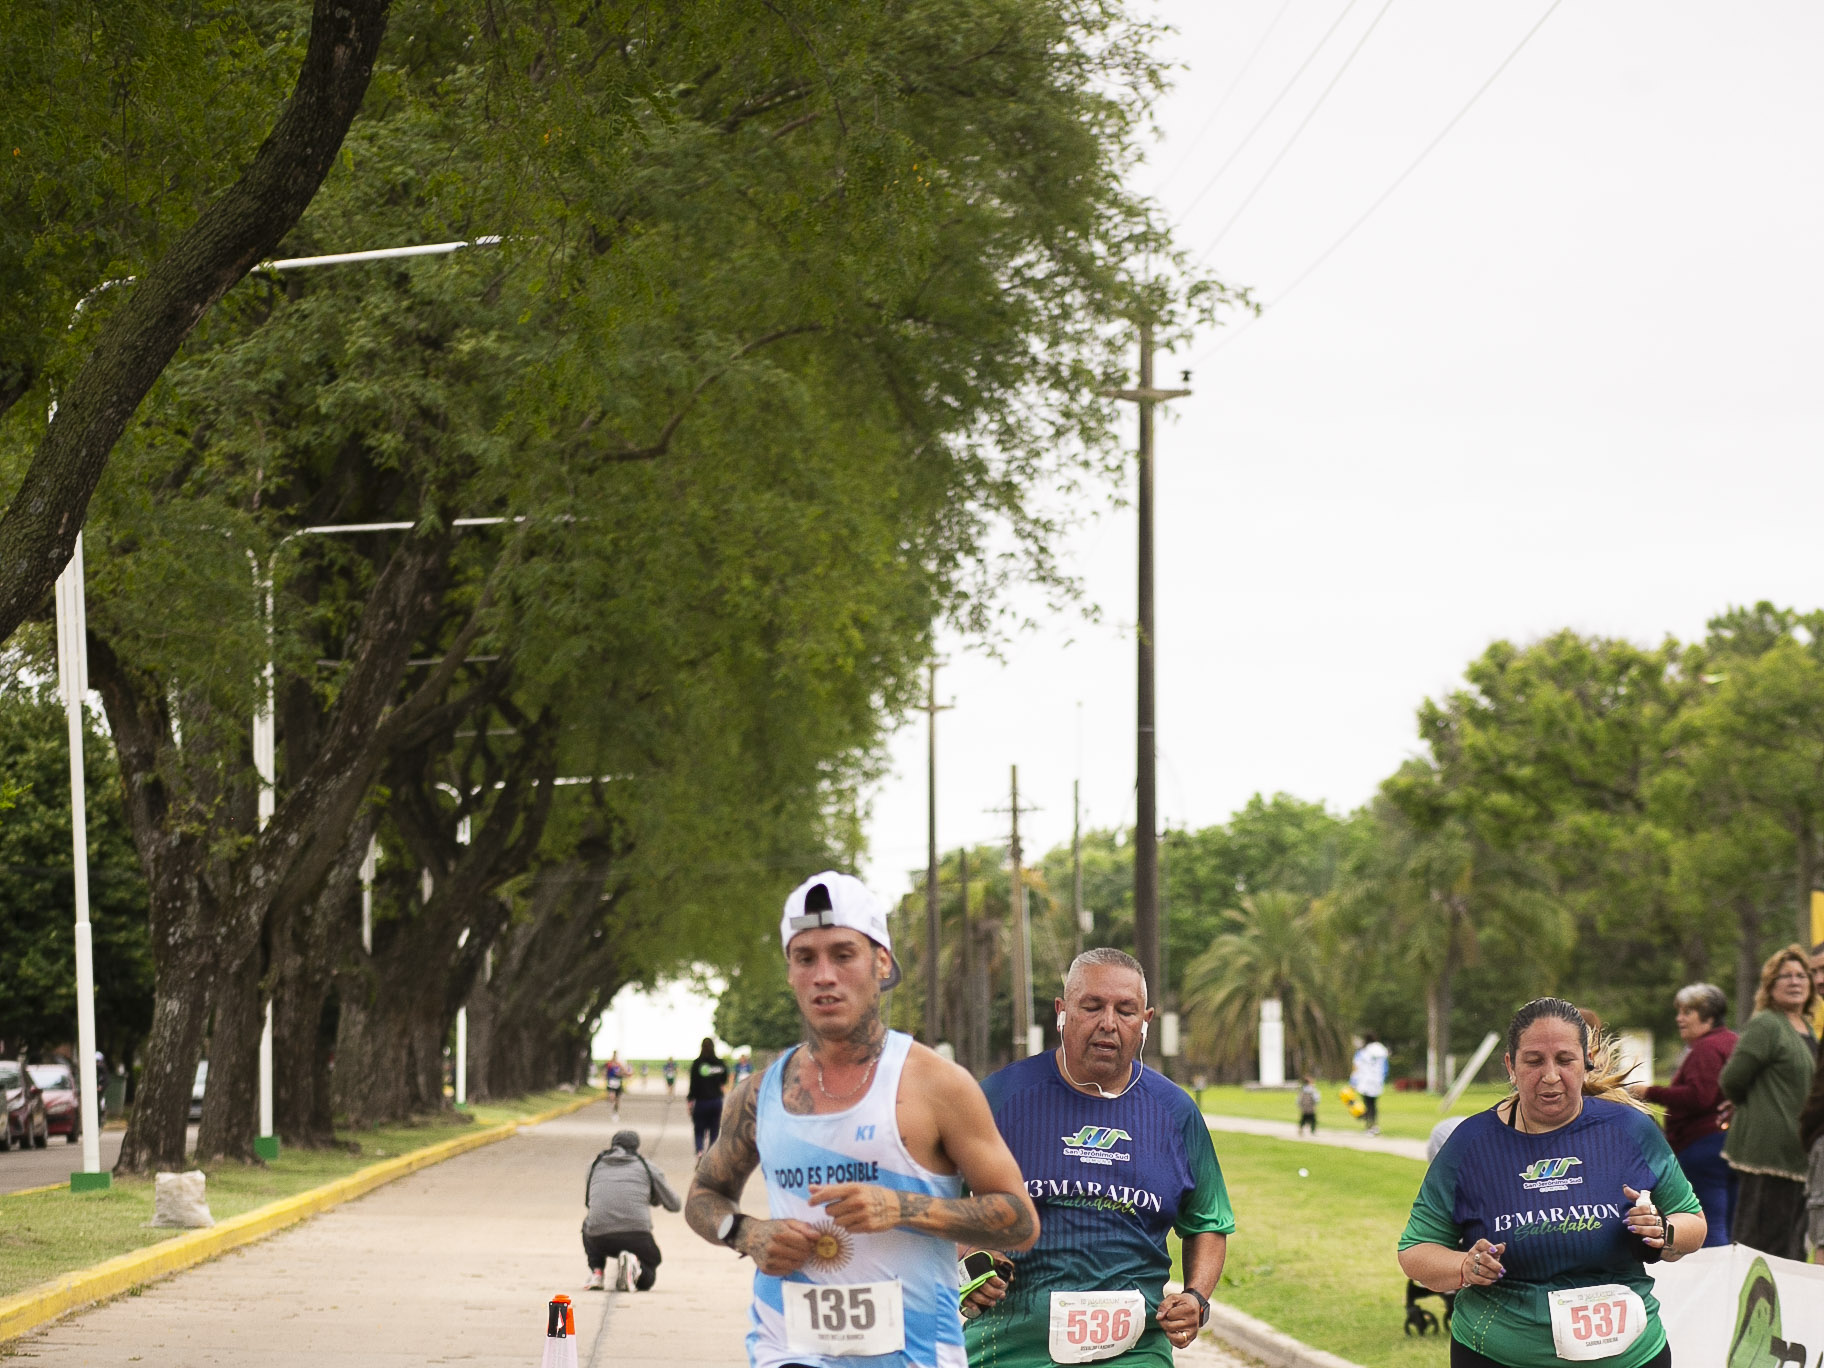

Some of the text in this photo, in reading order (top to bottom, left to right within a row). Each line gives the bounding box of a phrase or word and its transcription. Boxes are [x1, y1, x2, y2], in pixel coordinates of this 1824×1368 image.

[1115, 1152, 1130, 1161] Sud
[807, 1165, 822, 1185] ES
[826, 1161, 879, 1184] POSIBLE
[1513, 1214, 1603, 1242] Saludable
[803, 1287, 876, 1332] 135
[1570, 1299, 1627, 1340] 537
[1067, 1308, 1131, 1344] 536
